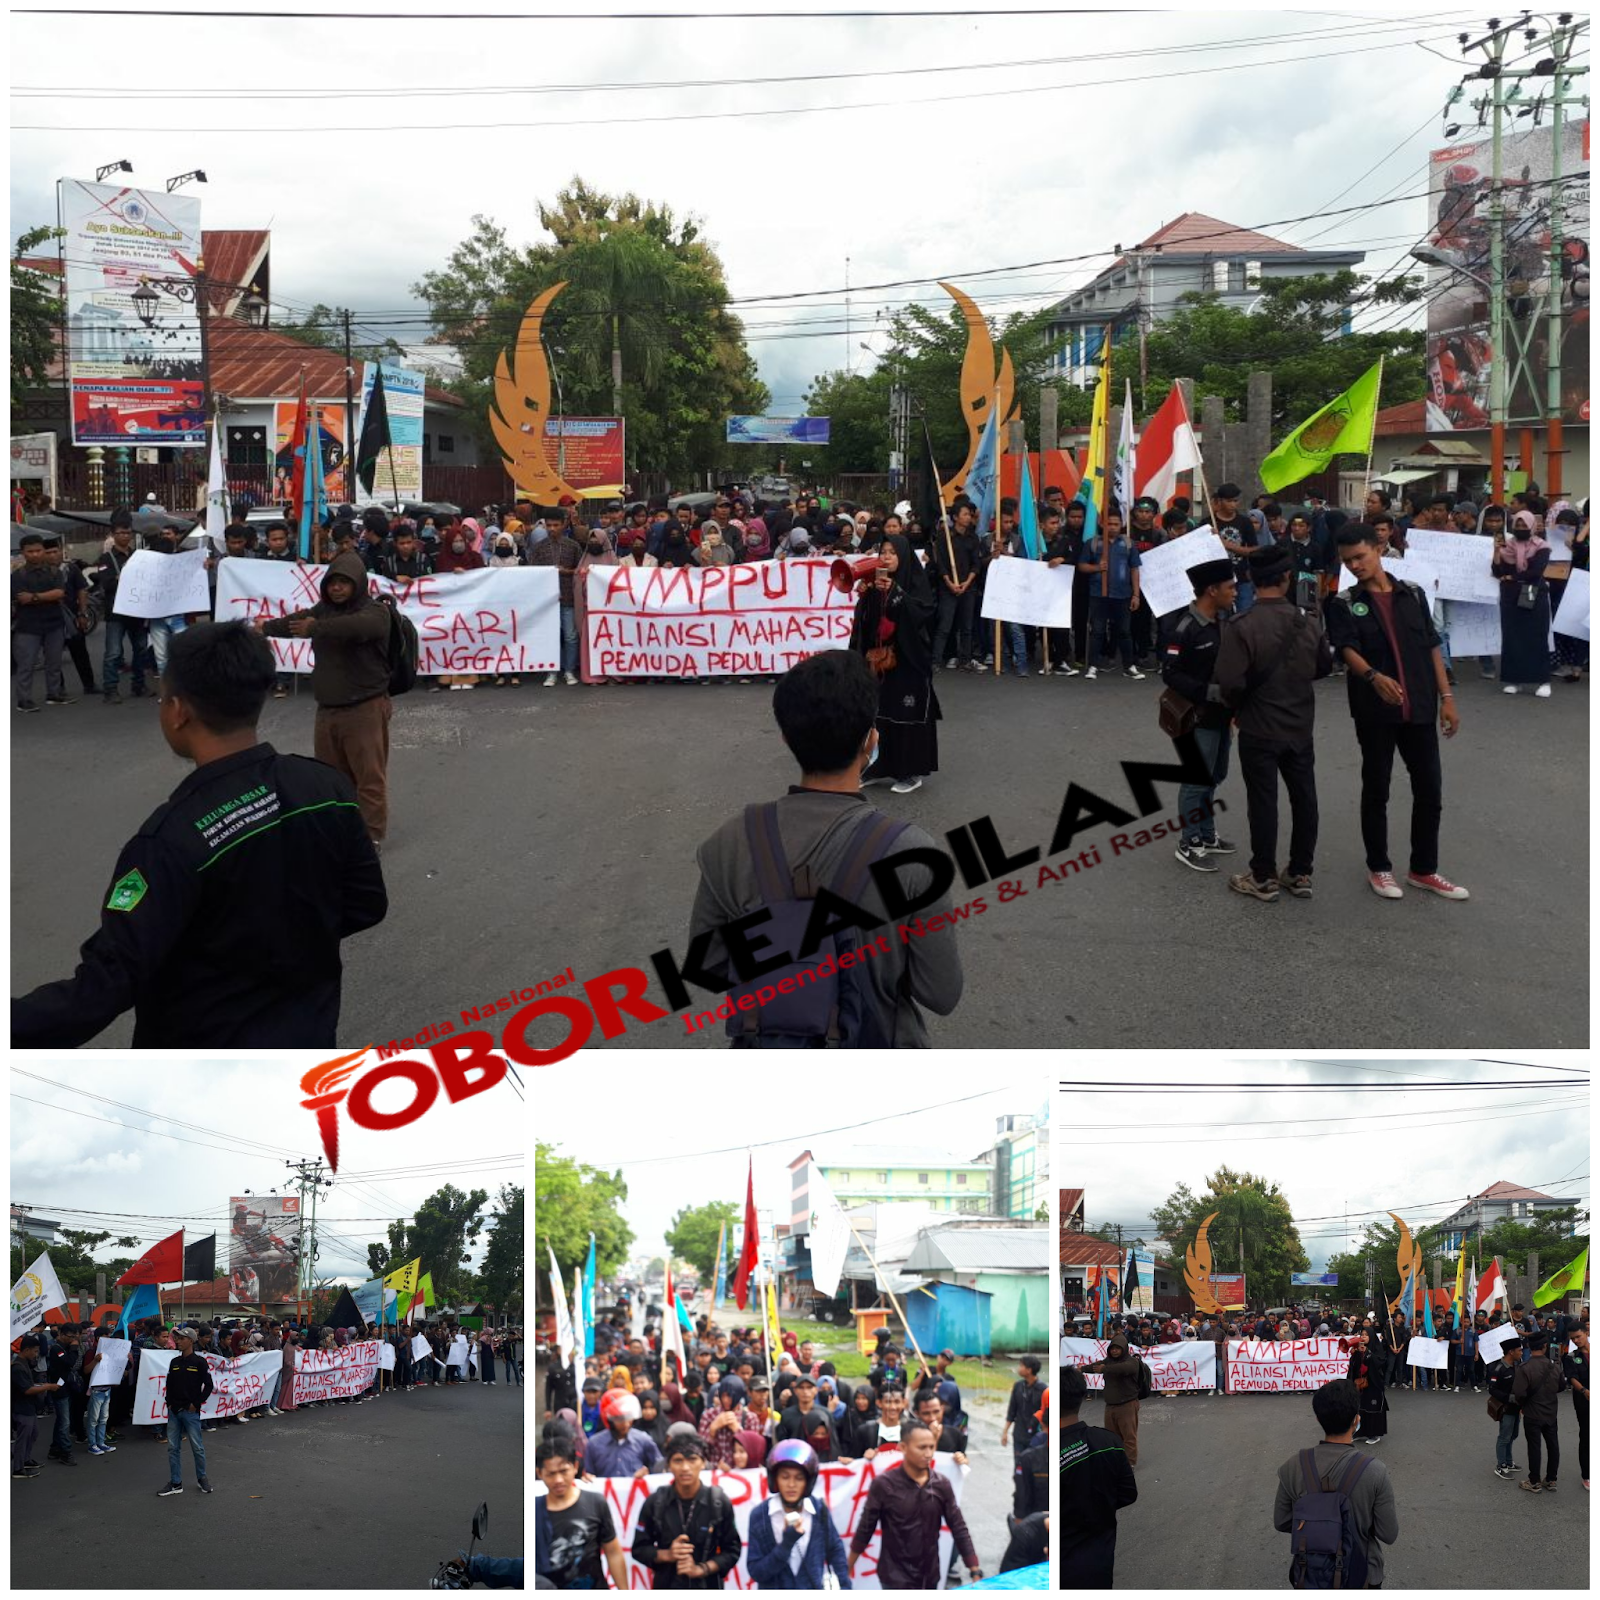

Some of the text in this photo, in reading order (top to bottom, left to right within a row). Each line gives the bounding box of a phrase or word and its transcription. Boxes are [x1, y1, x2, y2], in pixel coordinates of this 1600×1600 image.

[421, 609, 518, 644] SARI
[593, 613, 855, 649] ALIANSI MAHASIS
[601, 650, 698, 676] PEMUDA
[708, 650, 776, 674] PEDULI
[194, 799, 242, 830] KELUARGA
[240, 785, 269, 804] BESAR
[1153, 1360, 1198, 1377] SARI
[1231, 1362, 1350, 1379] ALIANSI MAHASIS
[294, 1372, 336, 1392] ALIANSI
[1233, 1378, 1279, 1392] PEMUDA
[1282, 1378, 1314, 1390] PEDULI
[295, 1387, 328, 1404] PEMUDA
